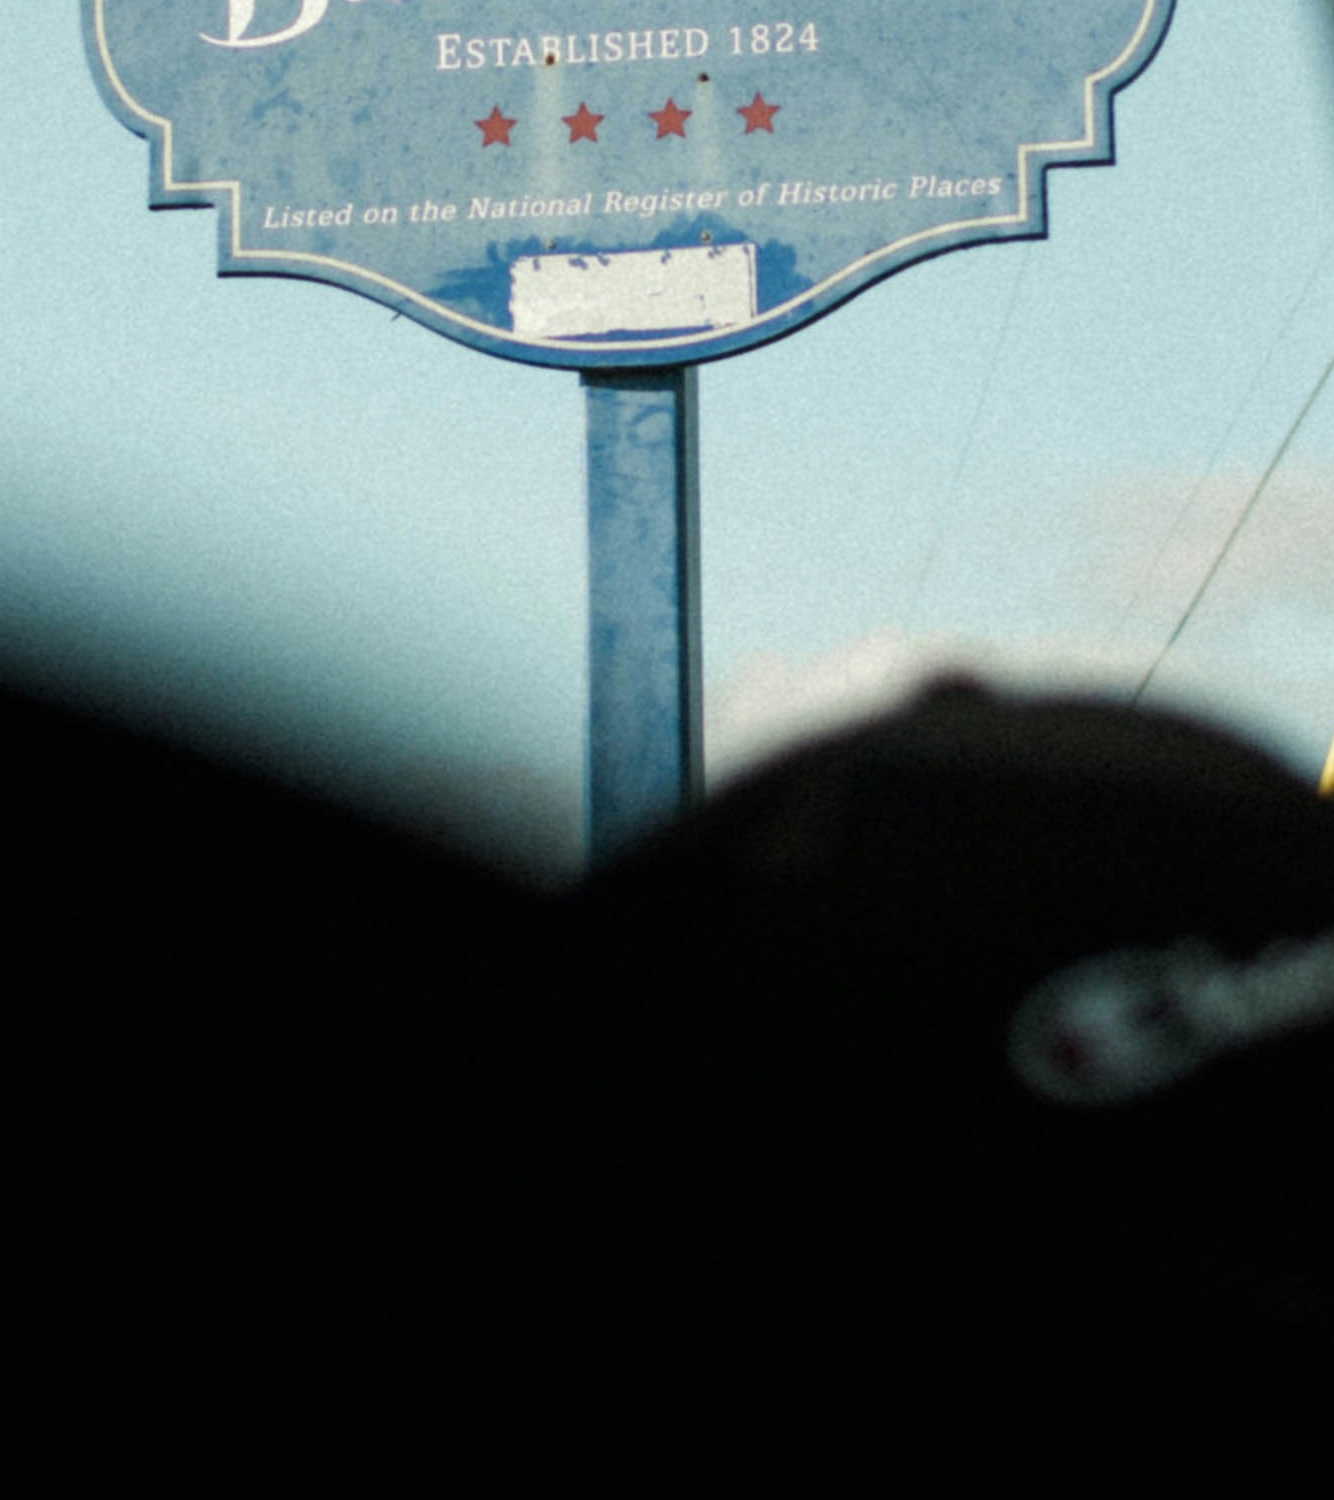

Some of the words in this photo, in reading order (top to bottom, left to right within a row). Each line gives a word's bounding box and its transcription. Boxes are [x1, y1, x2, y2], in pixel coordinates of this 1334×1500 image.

[435, 27, 709, 70] ESTABLISHED
[730, 22, 819, 55] 1824
[263, 203, 353, 228] Listed
[363, 205, 399, 224] on
[410, 199, 457, 222] the
[467, 193, 592, 220] National
[603, 188, 725, 217] Register
[738, 182, 769, 206] of
[778, 179, 898, 206] Historic
[909, 175, 1003, 198] Places
